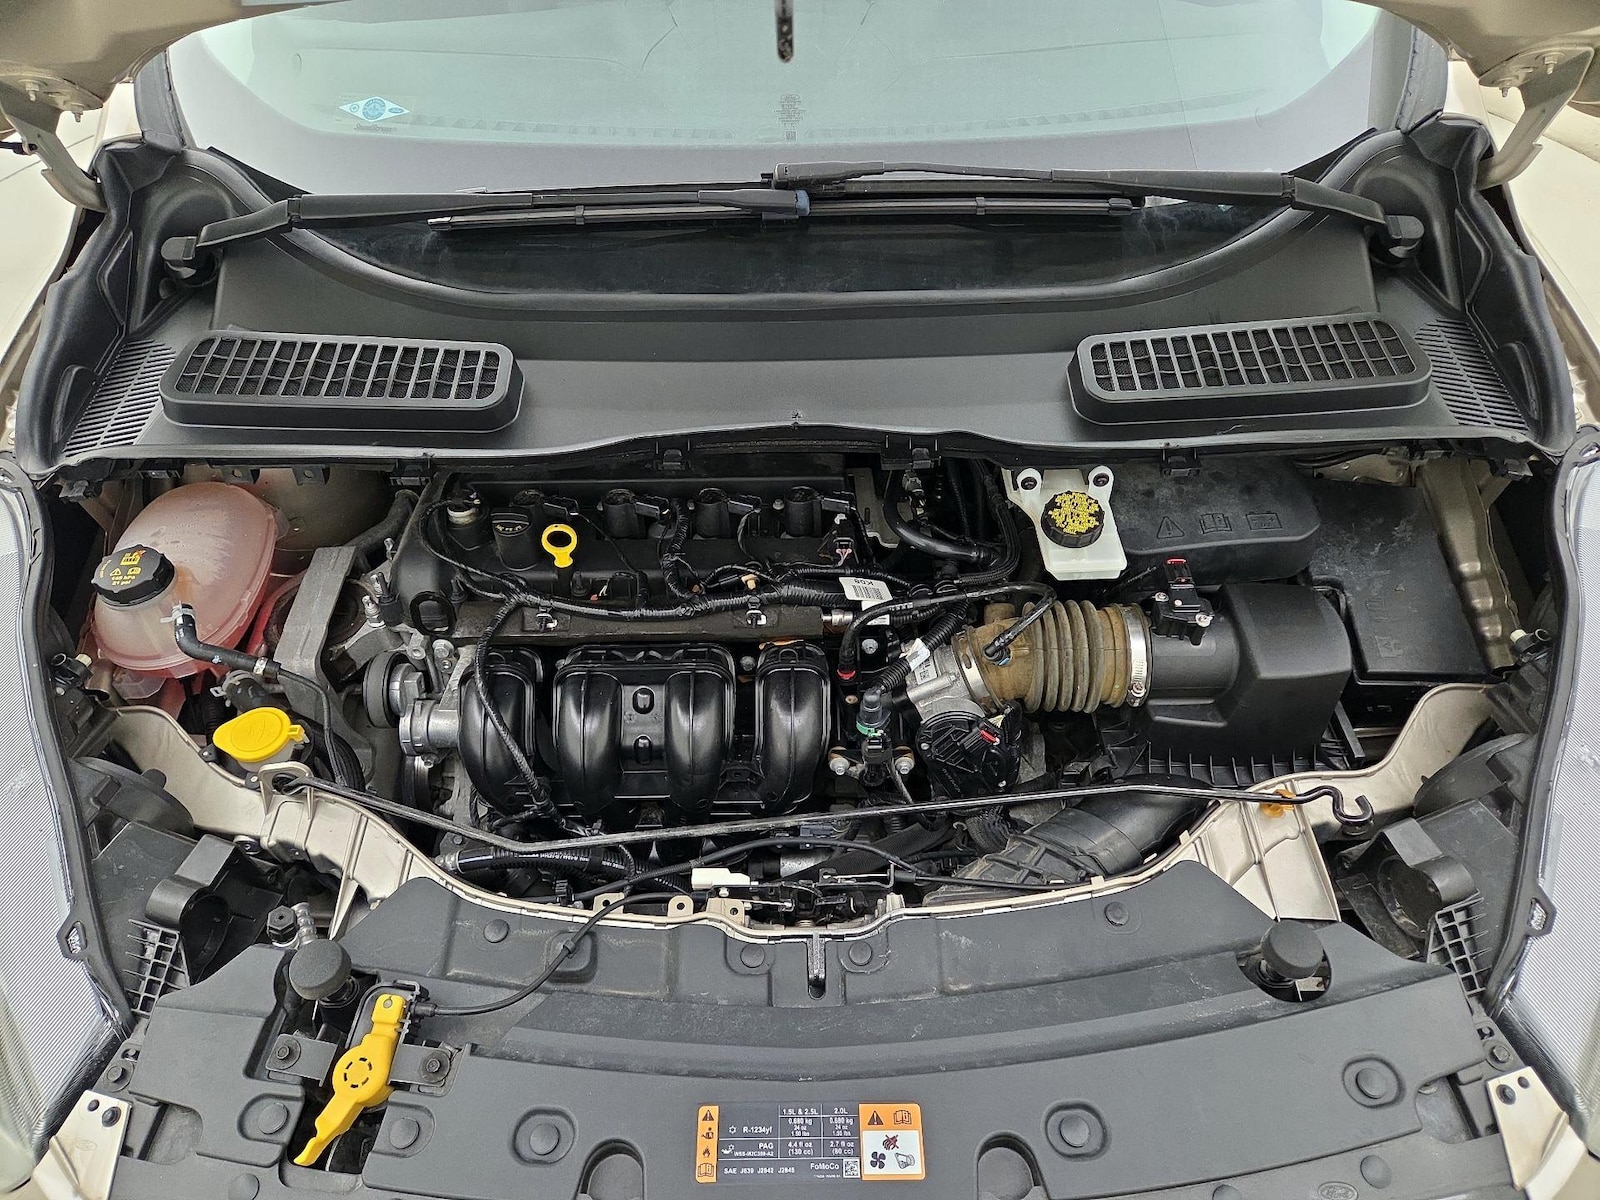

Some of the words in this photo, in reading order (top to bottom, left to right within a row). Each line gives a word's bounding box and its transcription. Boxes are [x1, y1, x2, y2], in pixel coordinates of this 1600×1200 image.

[804, 1118, 813, 1126] kg
[845, 1117, 854, 1126] kg
[742, 1126, 772, 1134] R-1234yf
[758, 1142, 774, 1150] PAG
[810, 1162, 840, 1170] FoMoCo
[723, 1167, 737, 1175] SAE
